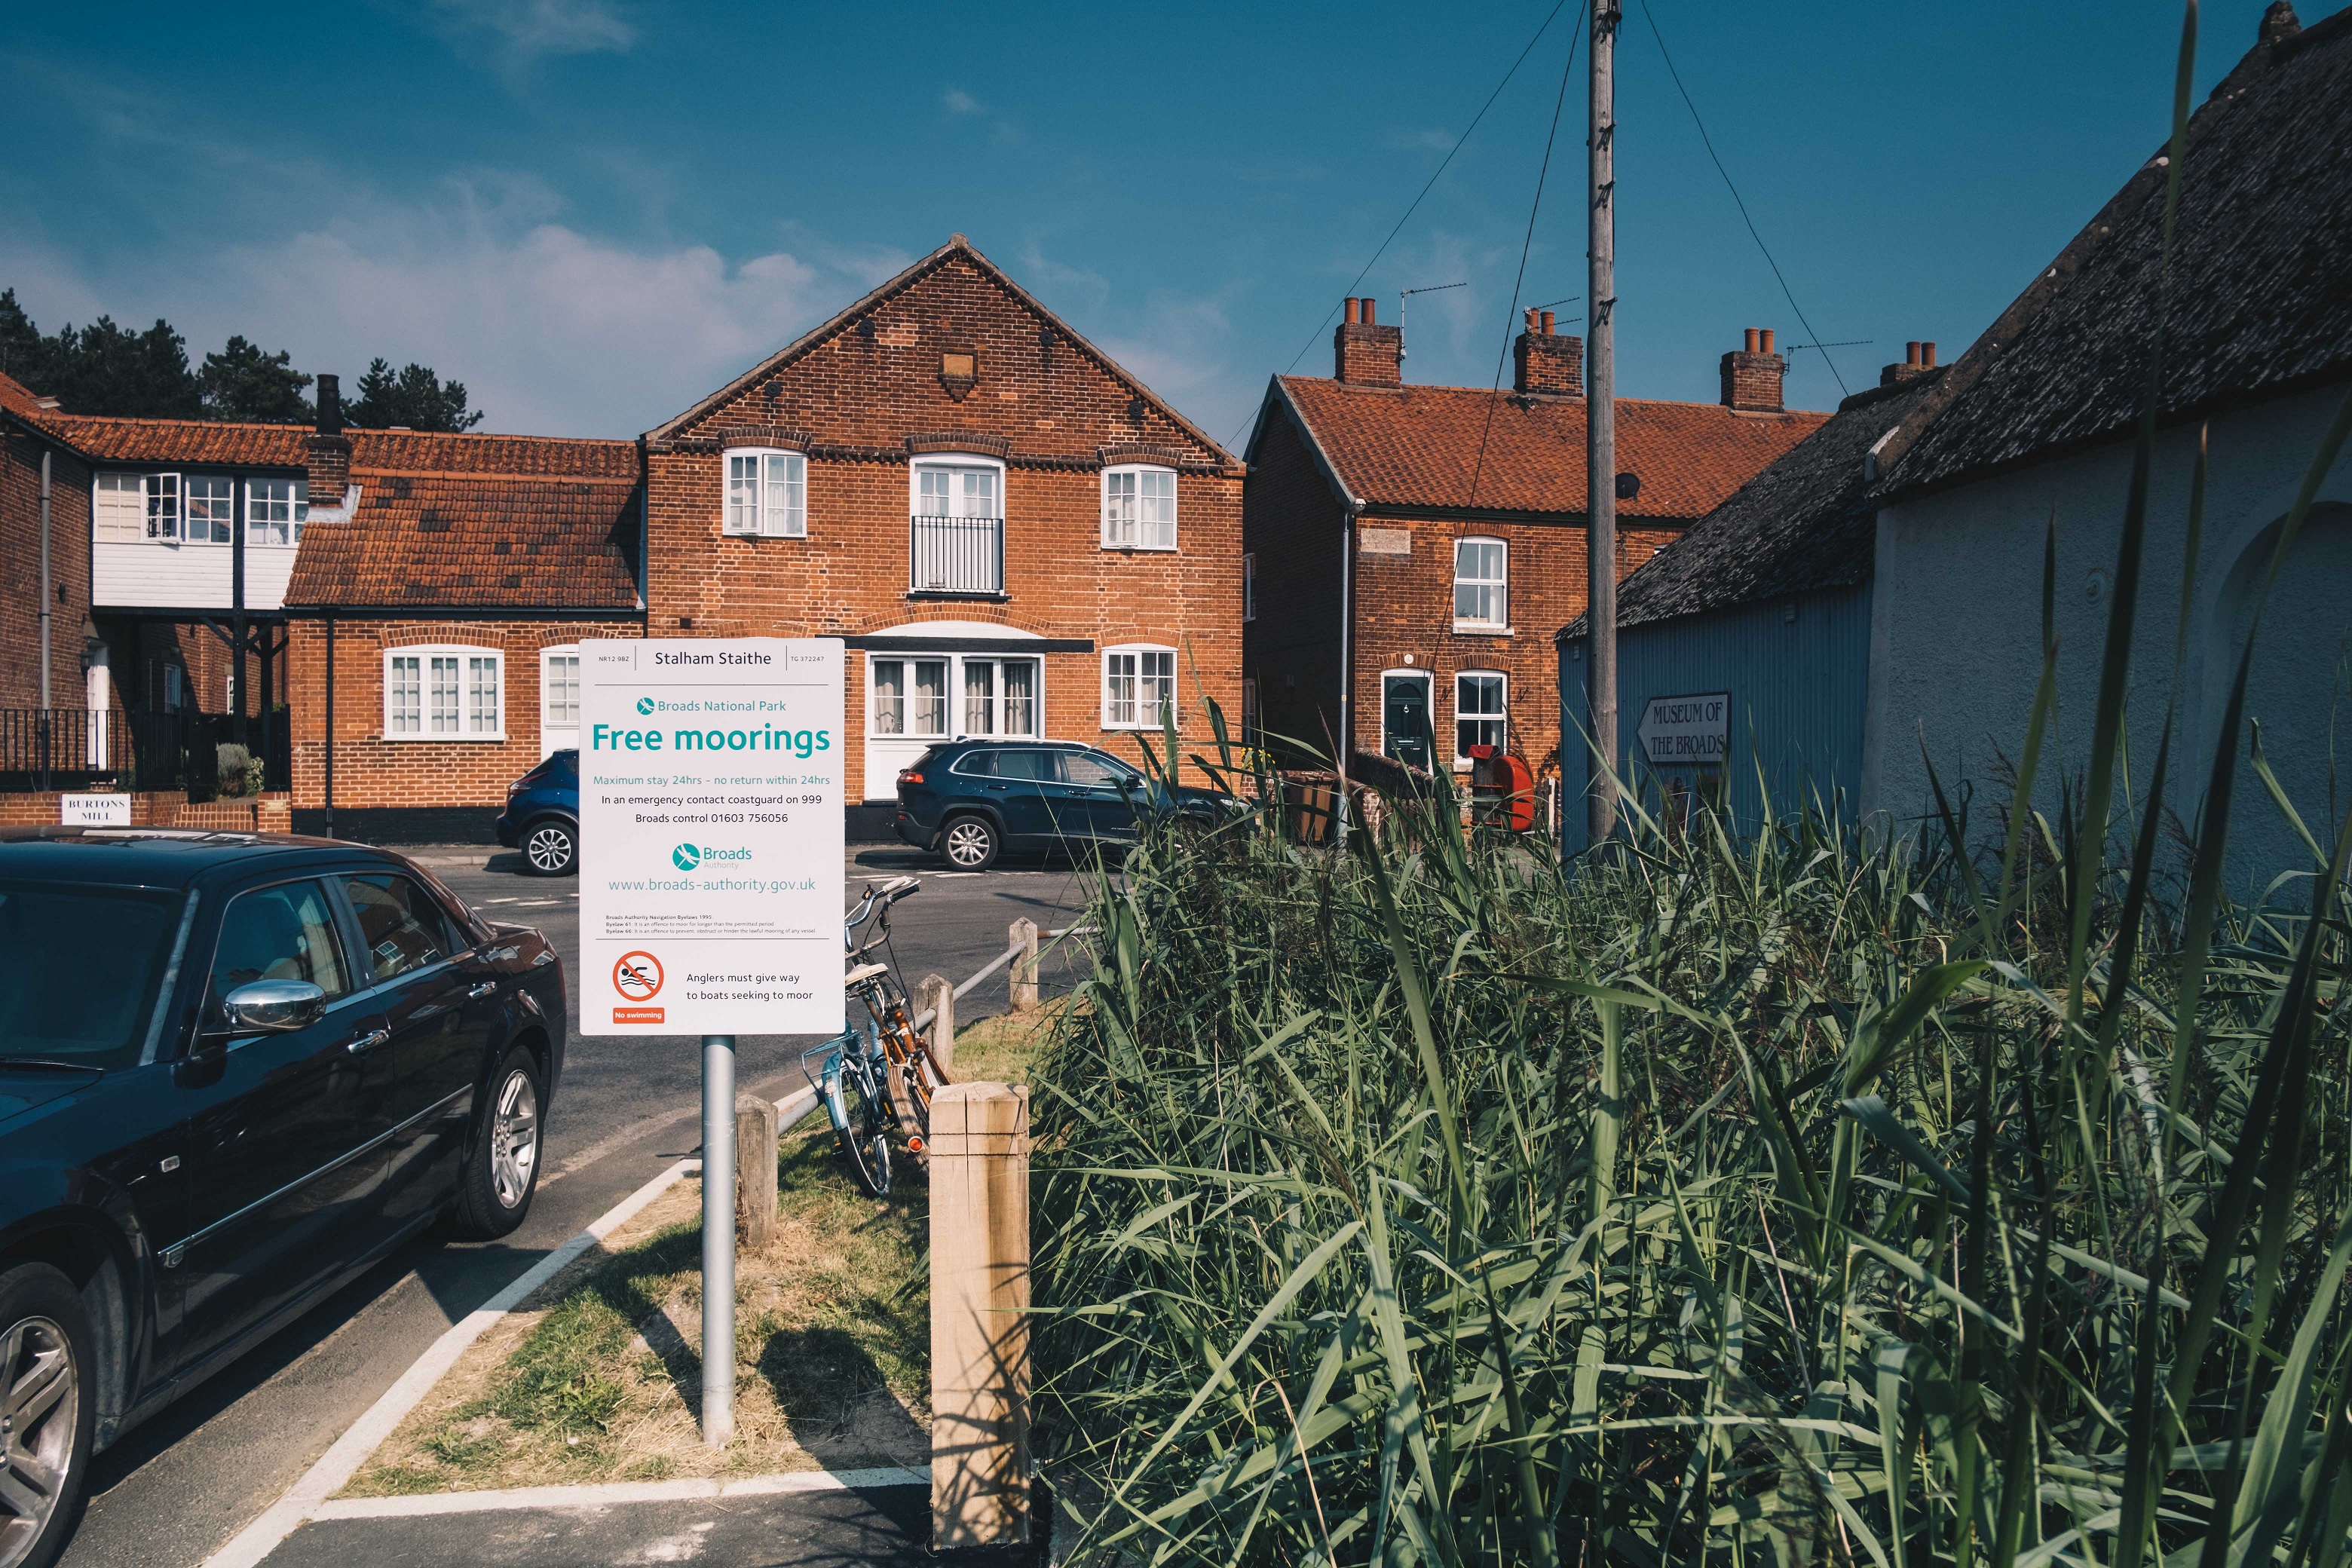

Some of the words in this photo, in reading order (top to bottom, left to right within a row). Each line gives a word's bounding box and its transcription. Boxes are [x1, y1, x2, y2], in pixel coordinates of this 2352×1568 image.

[654, 651, 714, 665] Stalham
[718, 651, 772, 665] Staithe
[658, 700, 700, 712] Broads
[704, 700, 755, 712] National
[759, 700, 787, 712] Park
[1653, 703, 1703, 724] MUSEUM
[1706, 702, 1723, 721] OF
[593, 724, 663, 751] Free
[675, 722, 831, 759] moorings
[1651, 736, 1673, 755] THE
[1676, 733, 1725, 755] BROADS
[593, 776, 645, 786] Maximum
[647, 776, 669, 788] stay
[672, 775, 703, 785] 24hrs
[730, 776, 763, 785] return
[765, 775, 798, 785] within
[801, 775, 831, 785] 24hrs
[69, 800, 125, 808] BURTONS
[602, 795, 611, 804] In
[628, 797, 684, 807] emergency
[686, 796, 725, 804] contact
[727, 795, 783, 807] coastguard
[801, 795, 822, 804] 999
[81, 812, 112, 820] MILL
[635, 813, 670, 823] Broads
[672, 813, 709, 823] control
[711, 813, 745, 823] 01603
[747, 813, 789, 823] 756056
[703, 847, 752, 860] Broads
[703, 861, 740, 871] Authority
[608, 877, 816, 894] www.broads-authority.gov.uk
[686, 972, 725, 985] Anglers
[727, 973, 753, 982] must
[755, 972, 777, 985] give
[779, 975, 801, 985] way
[686, 991, 698, 1000] to
[700, 990, 729, 1000] boats
[731, 990, 770, 1003] seeking
[772, 991, 784, 1000] to
[626, 1012, 662, 1020] swimming
